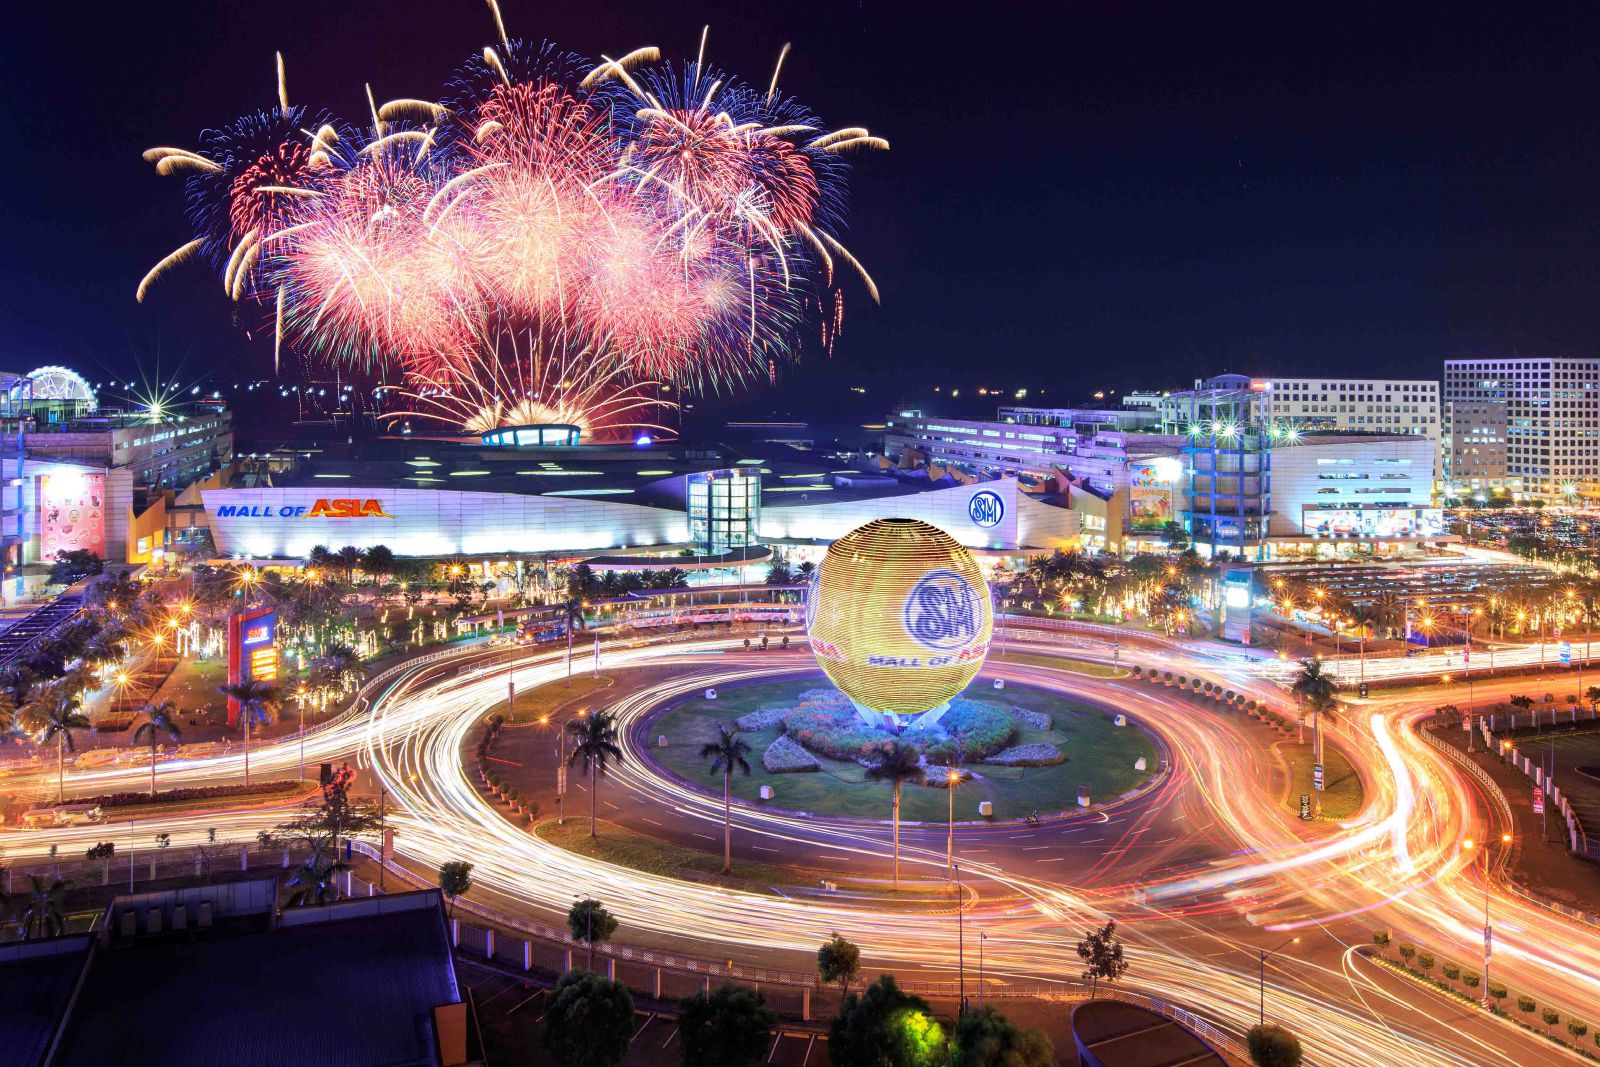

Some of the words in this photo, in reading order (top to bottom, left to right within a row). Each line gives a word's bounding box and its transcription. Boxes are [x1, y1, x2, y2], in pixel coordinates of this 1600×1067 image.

[217, 505, 273, 518] MALL
[278, 506, 307, 518] OF
[308, 498, 385, 519] ASIA
[971, 494, 999, 524] SM
[912, 583, 976, 642] SM
[867, 655, 922, 669] MALL
